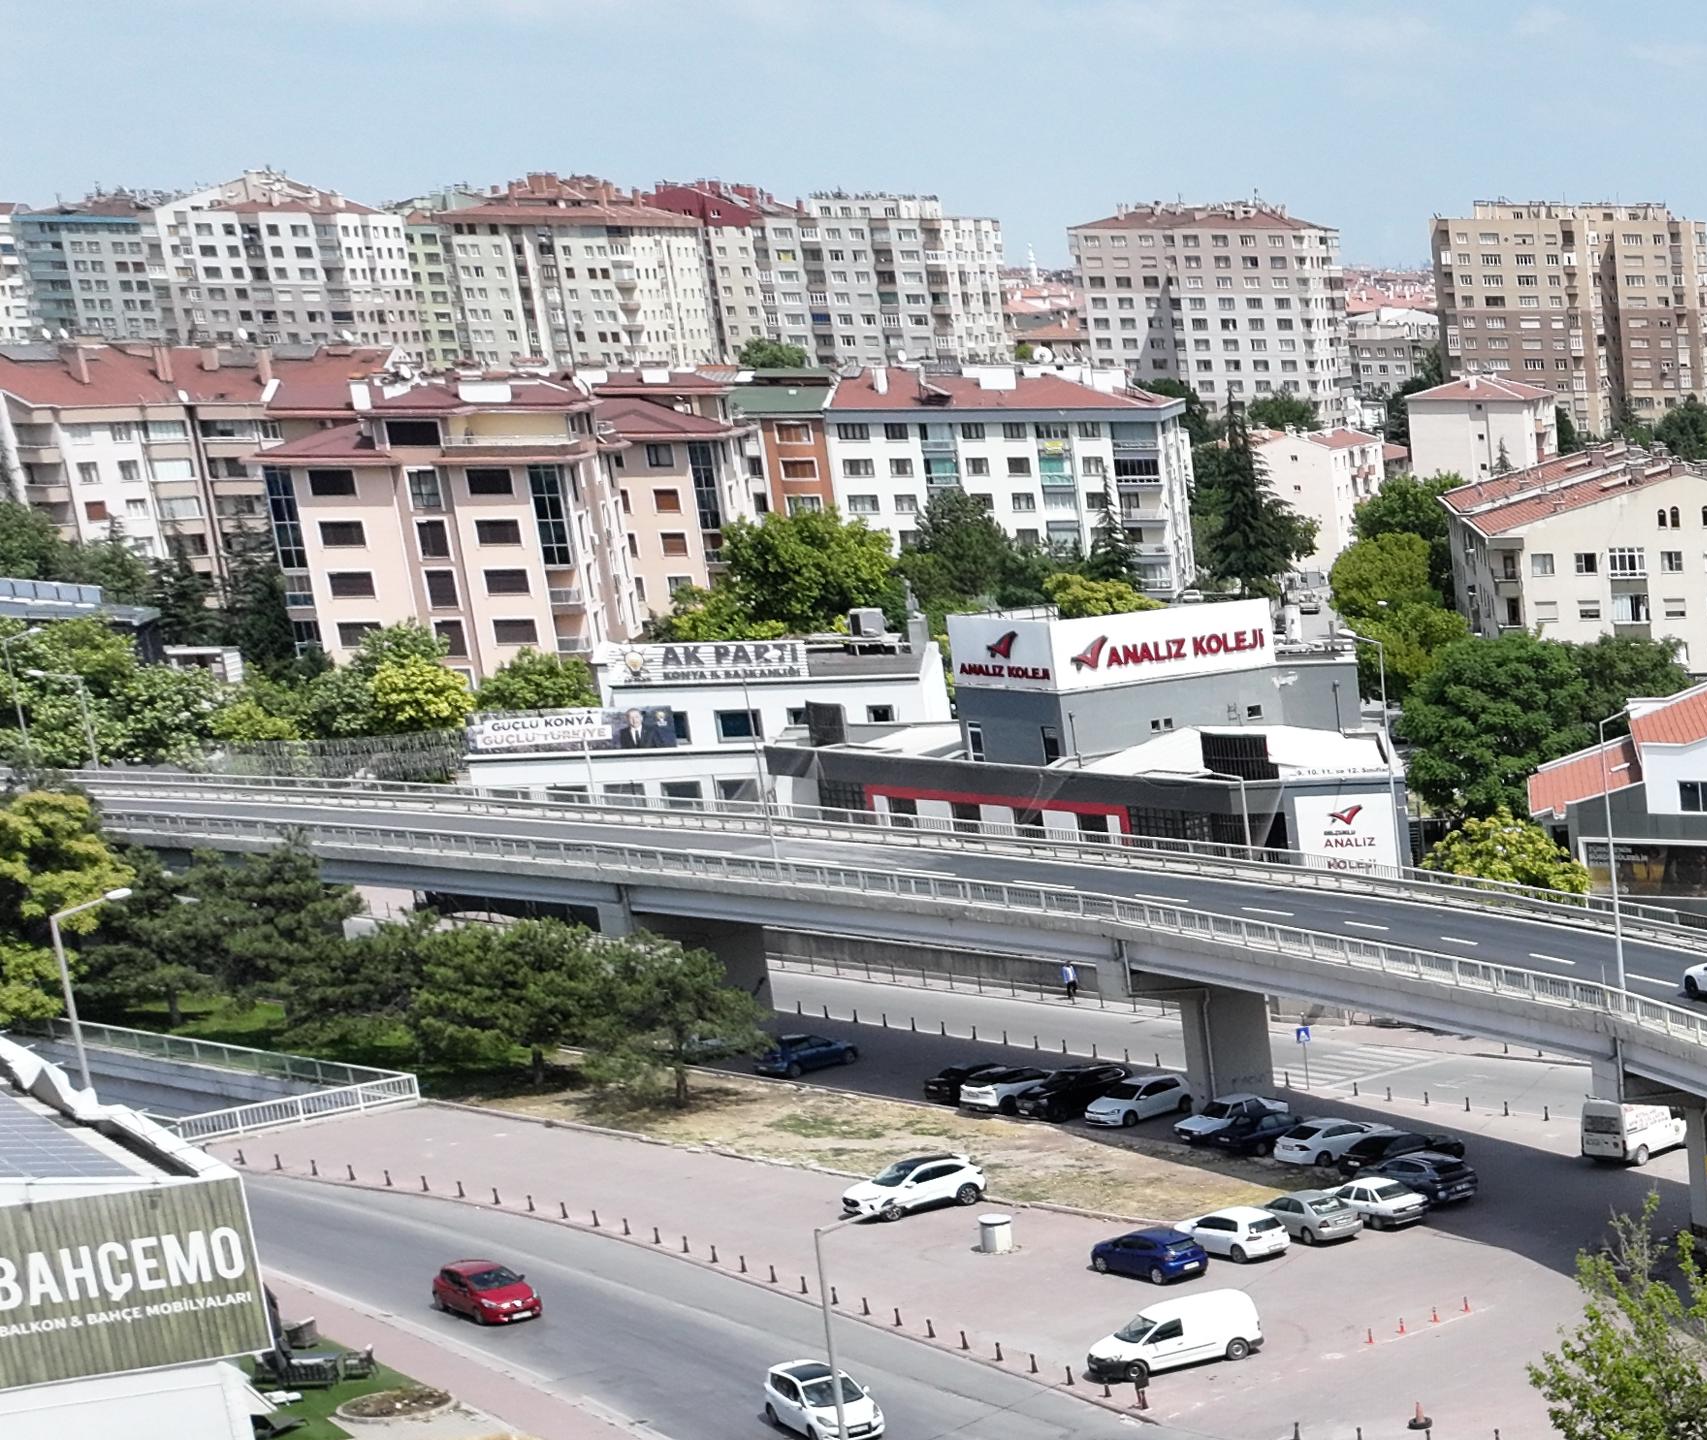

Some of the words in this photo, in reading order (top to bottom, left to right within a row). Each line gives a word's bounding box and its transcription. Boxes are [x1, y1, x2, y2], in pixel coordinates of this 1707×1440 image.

[662, 646, 704, 667] AK
[663, 669, 707, 680] KONYA
[544, 715, 594, 727] KONYA
[0, 1226, 245, 1312] BAHÇEMO
[0, 1317, 67, 1338] BALKON
[70, 1315, 83, 1328] &
[86, 1307, 142, 1325] BAHÇE
[146, 1291, 253, 1318] MOBİLYALARI
